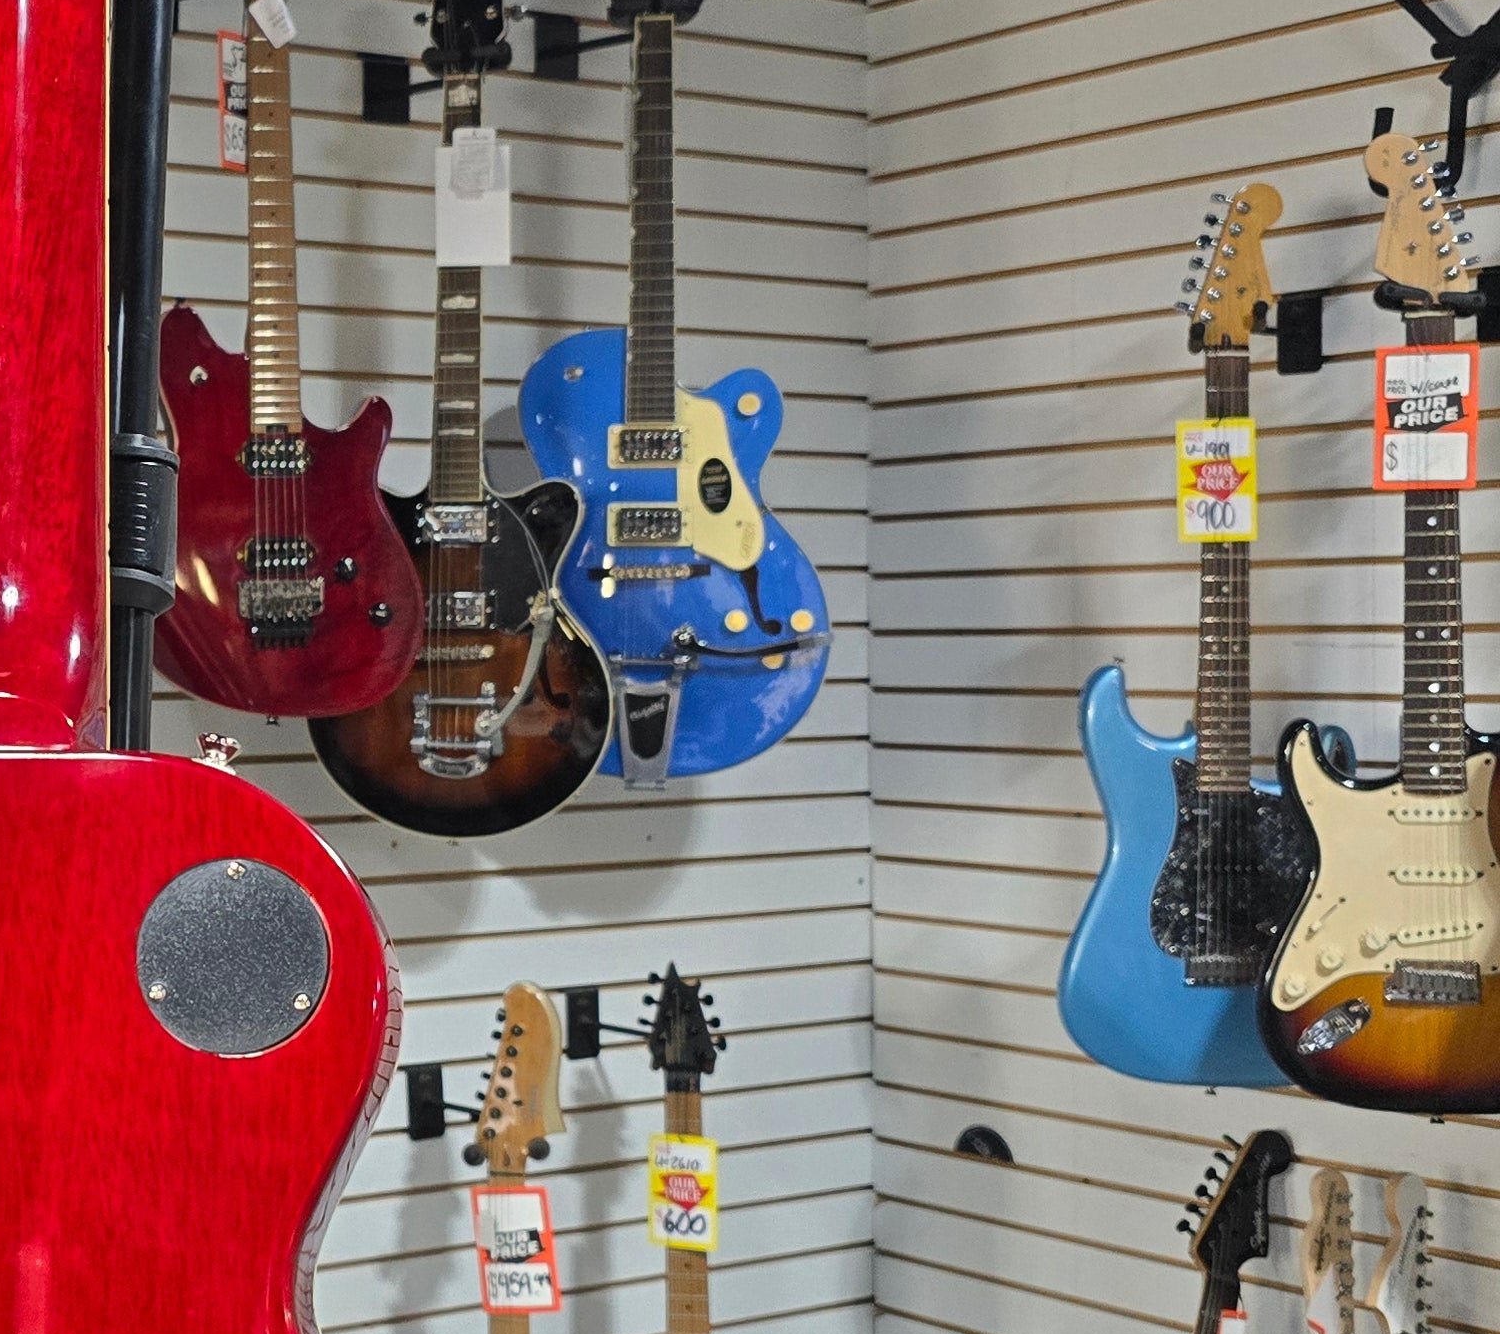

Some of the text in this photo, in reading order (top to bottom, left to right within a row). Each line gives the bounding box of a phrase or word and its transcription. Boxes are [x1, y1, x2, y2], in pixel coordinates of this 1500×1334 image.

[229, 83, 247, 98] OU
[1400, 395, 1448, 414] OUR
[1393, 406, 1459, 429] PRICE
[1385, 440, 1398, 473] $
[1200, 464, 1234, 478] OUR
[1196, 476, 1240, 491] PRICE
[668, 1176, 696, 1188] OUR
[664, 1187, 701, 1203] PRICE
